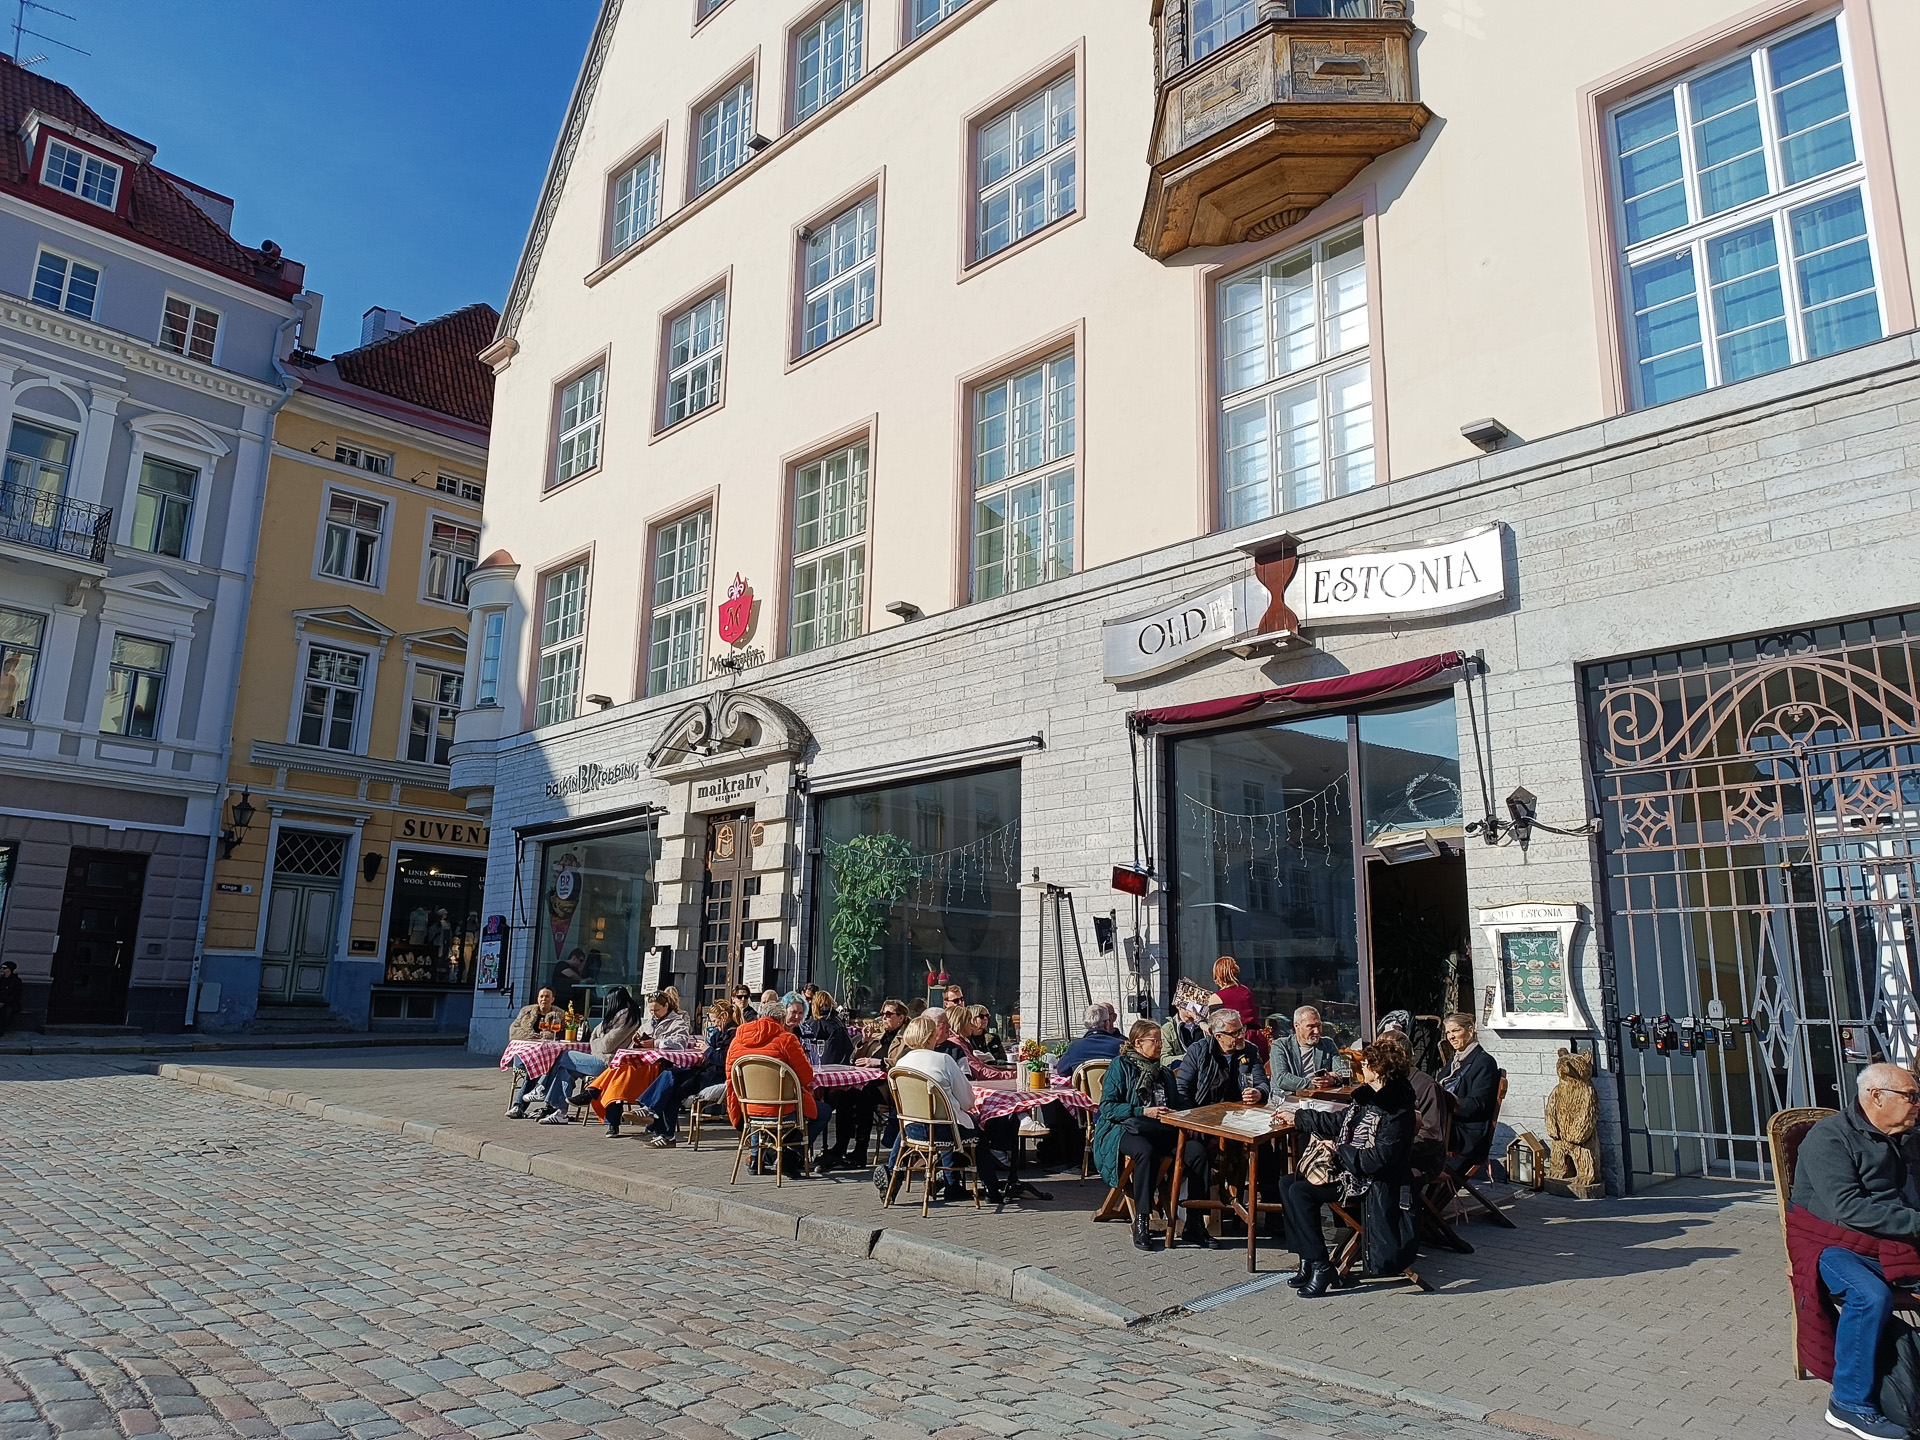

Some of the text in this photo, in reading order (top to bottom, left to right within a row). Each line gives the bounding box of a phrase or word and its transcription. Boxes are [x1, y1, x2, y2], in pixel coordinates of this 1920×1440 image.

[1313, 551, 1482, 605] ESTONIA
[697, 773, 762, 799] maikrahv
[408, 869, 429, 877] LINEN
[428, 880, 462, 889] CERAMICS
[1520, 908, 1563, 919] ESTONIA
